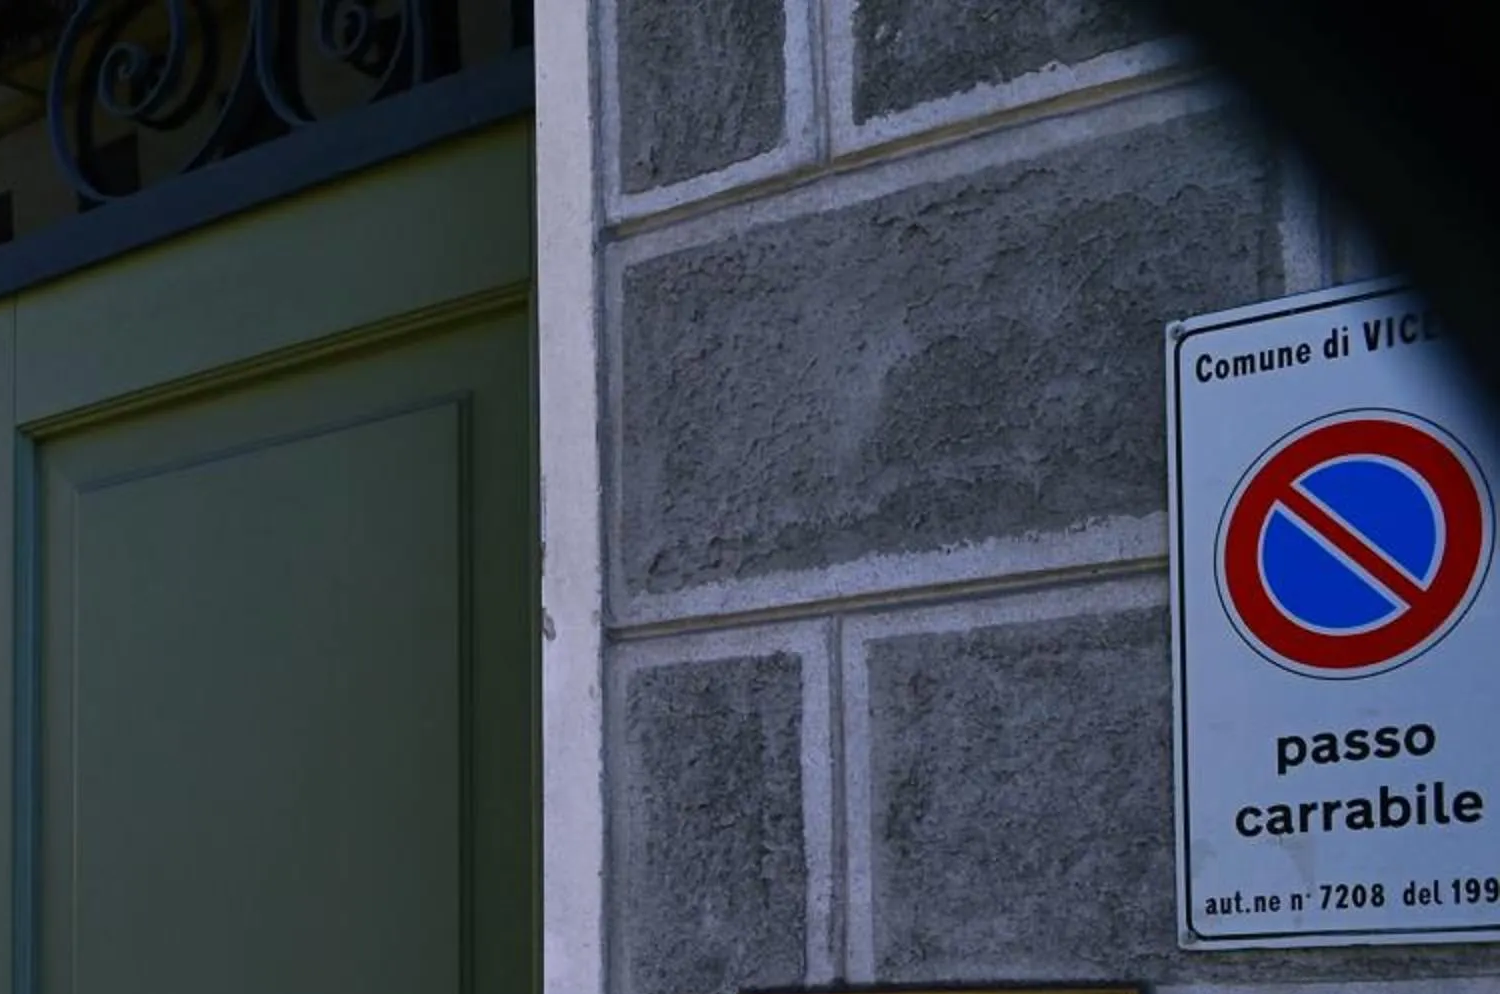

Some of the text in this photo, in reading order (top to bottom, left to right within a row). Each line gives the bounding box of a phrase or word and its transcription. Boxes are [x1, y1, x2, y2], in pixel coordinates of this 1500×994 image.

[1195, 340, 1312, 382] Comune
[1323, 325, 1349, 360] di
[1277, 723, 1436, 775] passo
[1235, 781, 1484, 838] carrabile
[1205, 890, 1281, 915] aut.ne
[1319, 883, 1385, 910] 7208
[1403, 879, 1444, 907] del
